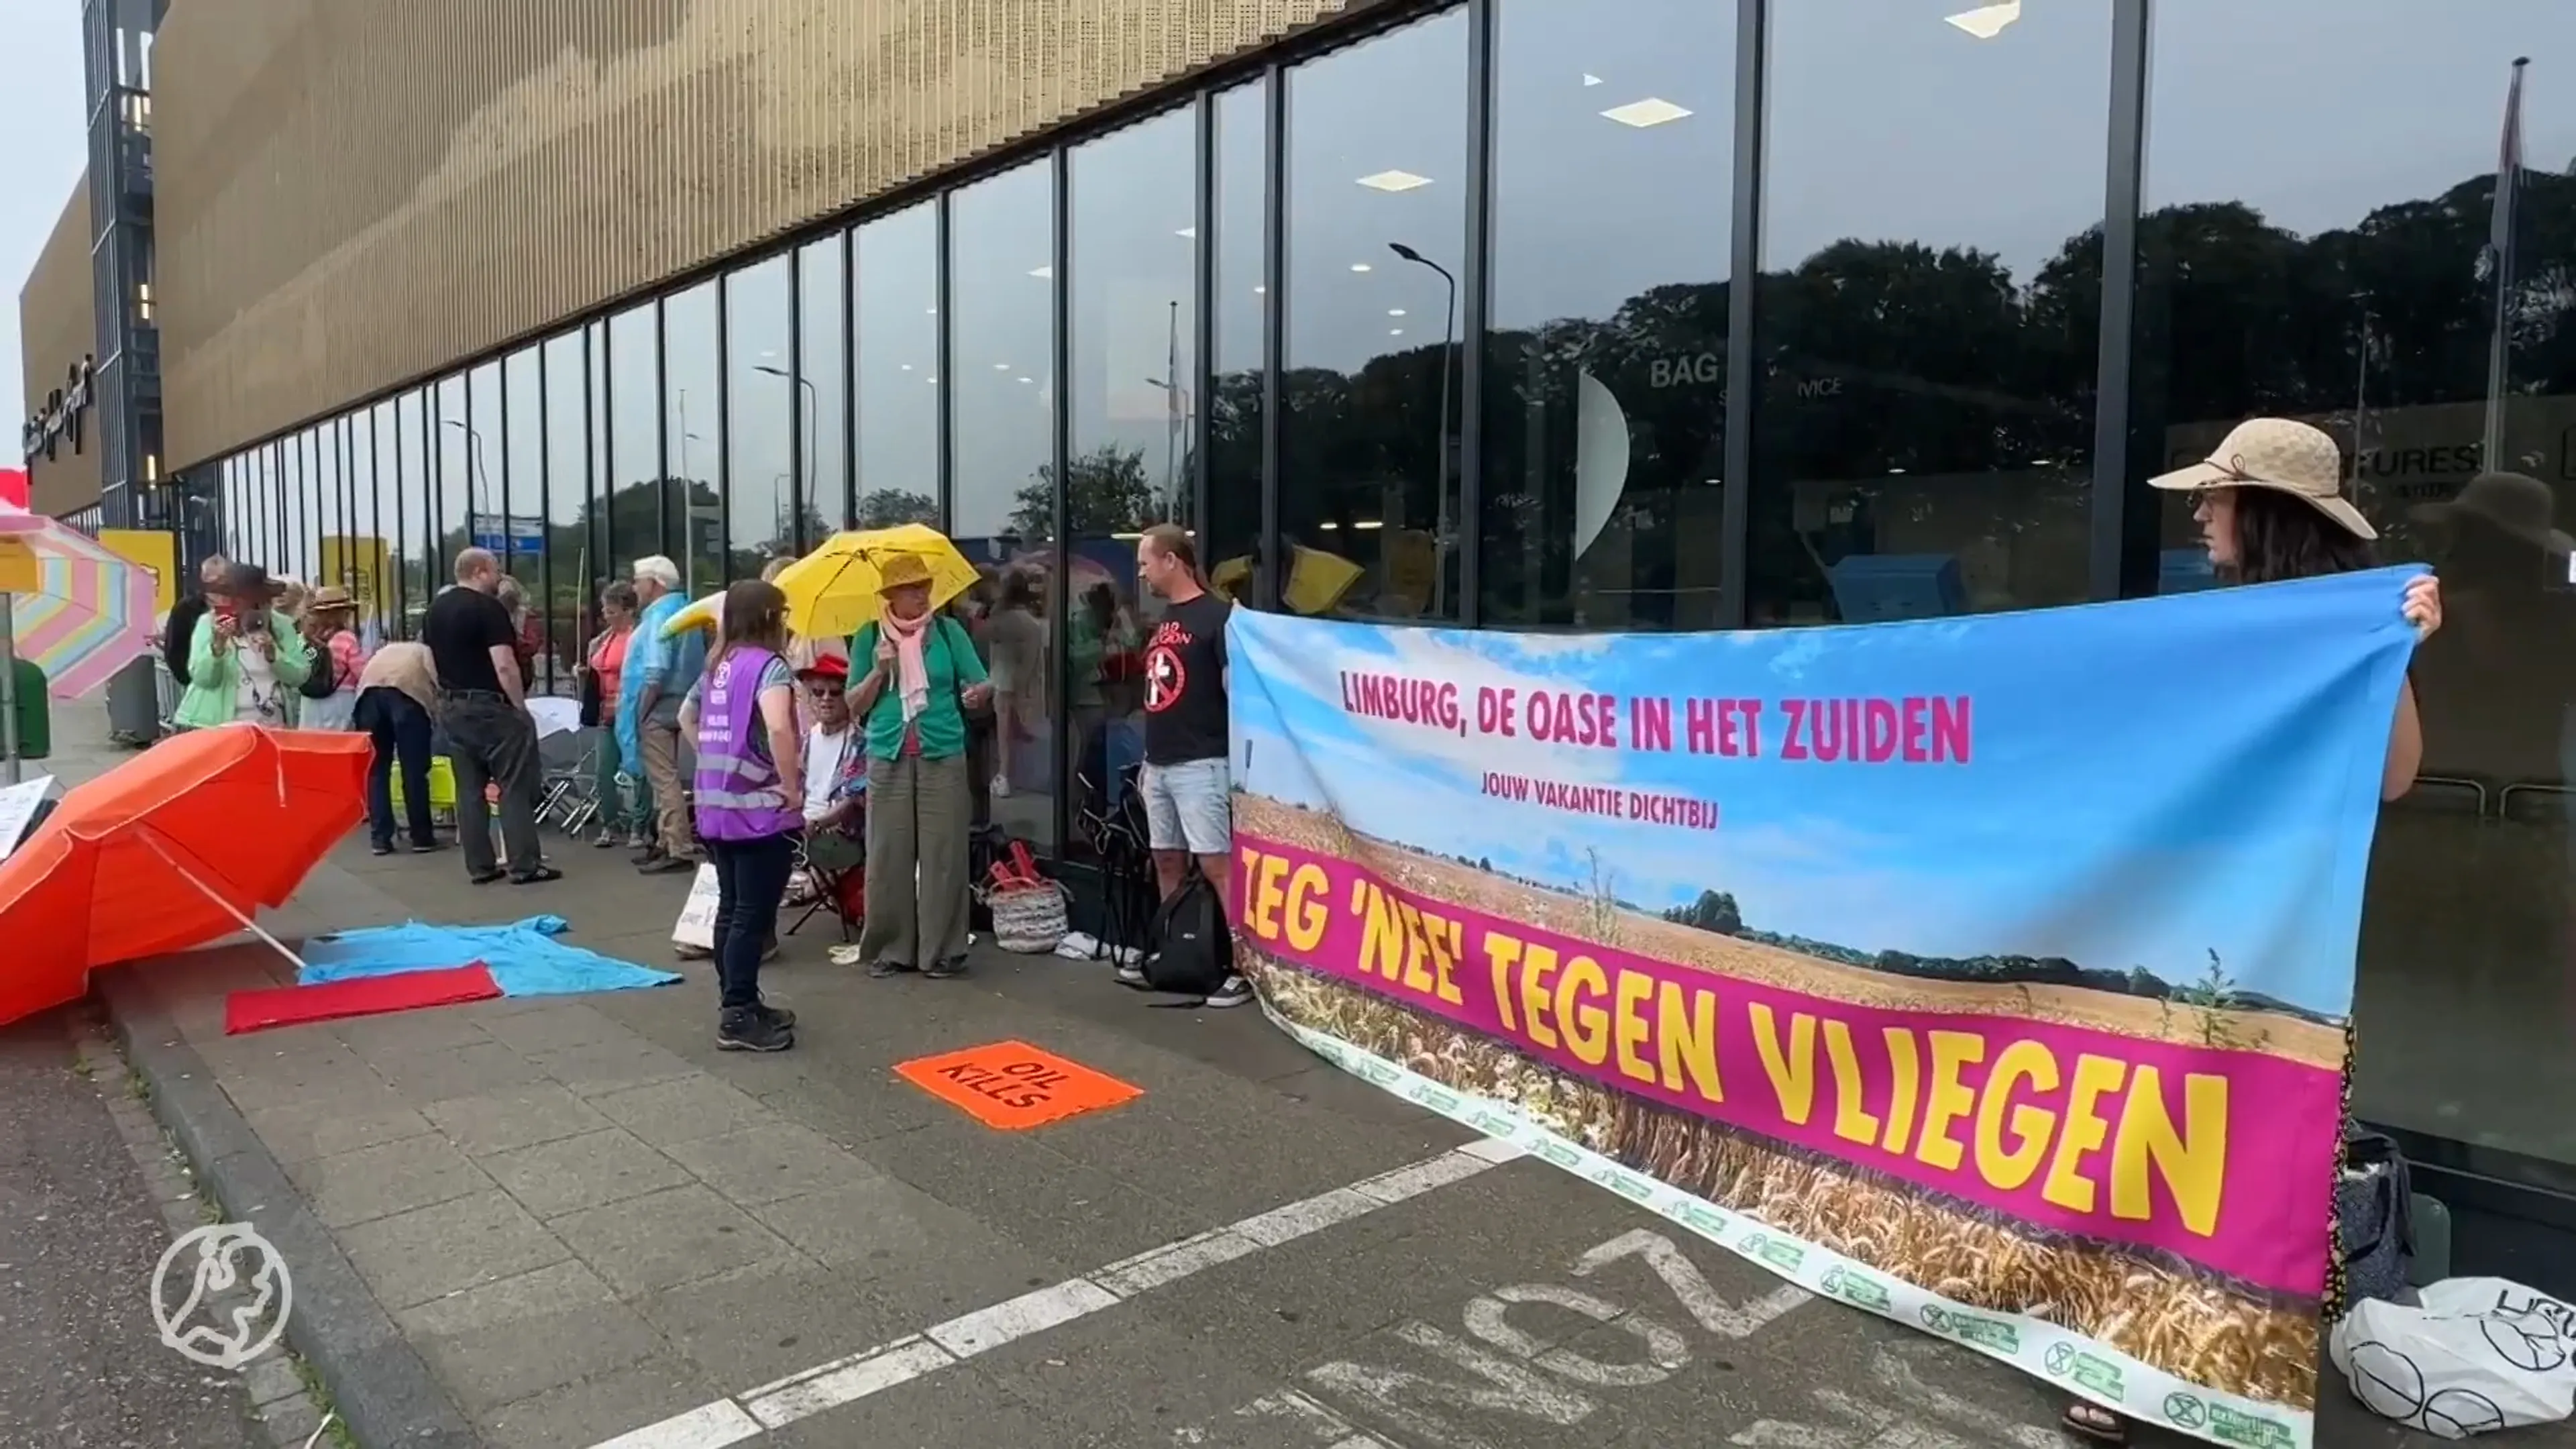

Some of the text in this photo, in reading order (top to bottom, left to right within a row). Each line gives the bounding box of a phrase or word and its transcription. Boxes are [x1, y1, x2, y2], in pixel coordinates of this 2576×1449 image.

[1650, 352, 1719, 388] BAG
[1340, 671, 1971, 763] LIMBURG, DE OASE IN HET ZUIDEN
[1481, 771, 1719, 830] JOUW VAKANTIE DICHTBIJ
[936, 1062, 1052, 1108] KILLS
[1002, 1062, 1071, 1089] OIL
[1483, 932, 1725, 1104] TEGEN
[1749, 1003, 2229, 1237] VLIEGEN
